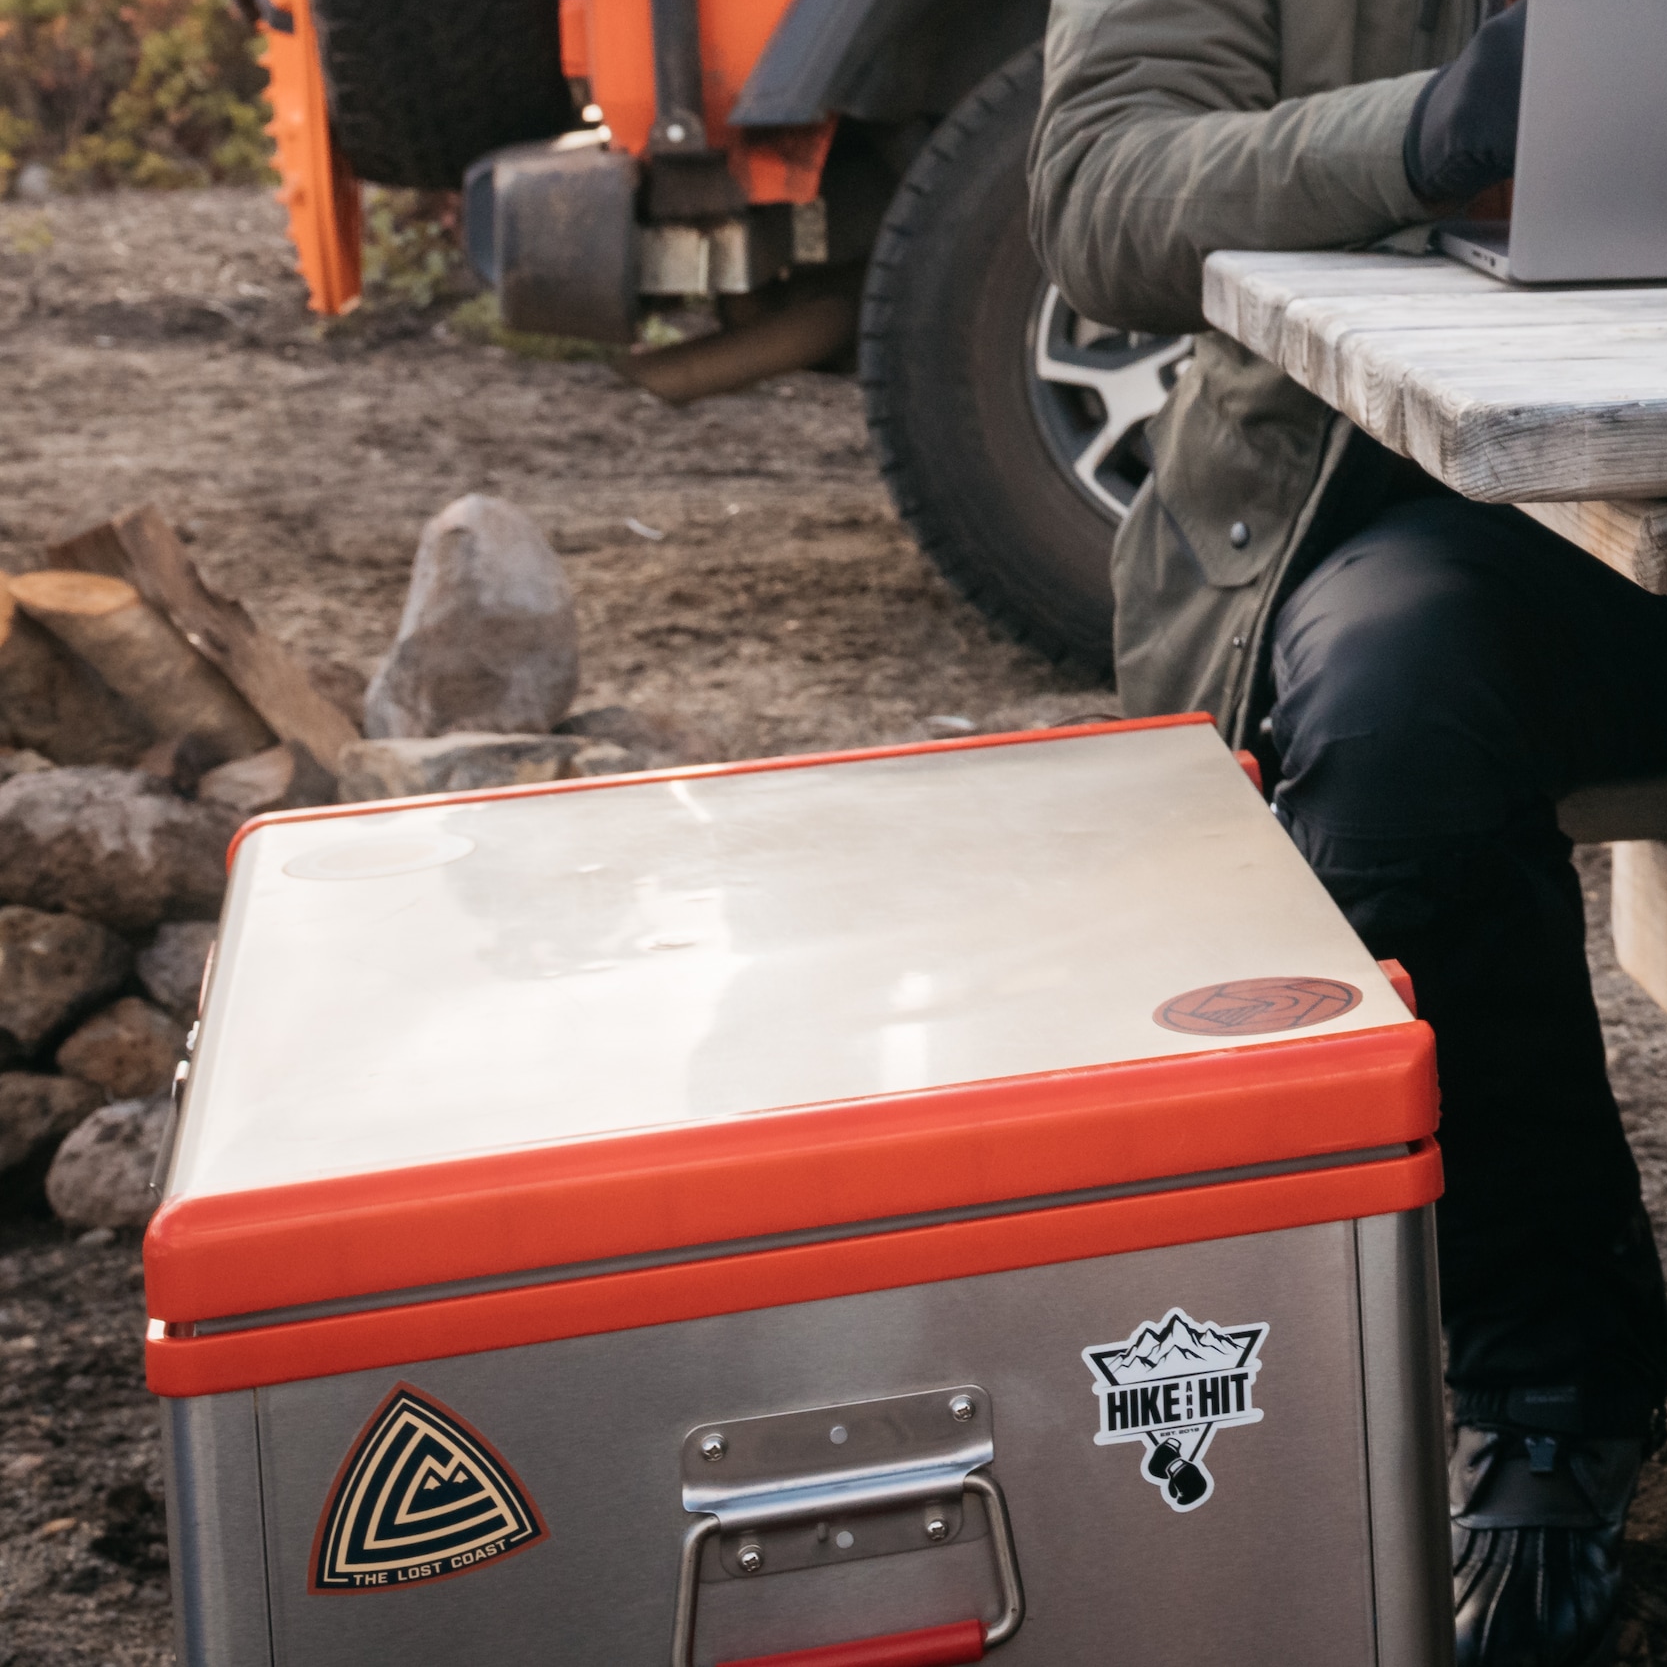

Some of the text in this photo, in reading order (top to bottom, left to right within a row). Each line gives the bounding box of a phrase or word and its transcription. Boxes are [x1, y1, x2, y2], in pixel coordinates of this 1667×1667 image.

[1107, 1372, 1249, 1431] HIKE AND HIT
[353, 1539, 507, 1586] THE LOST COAST
